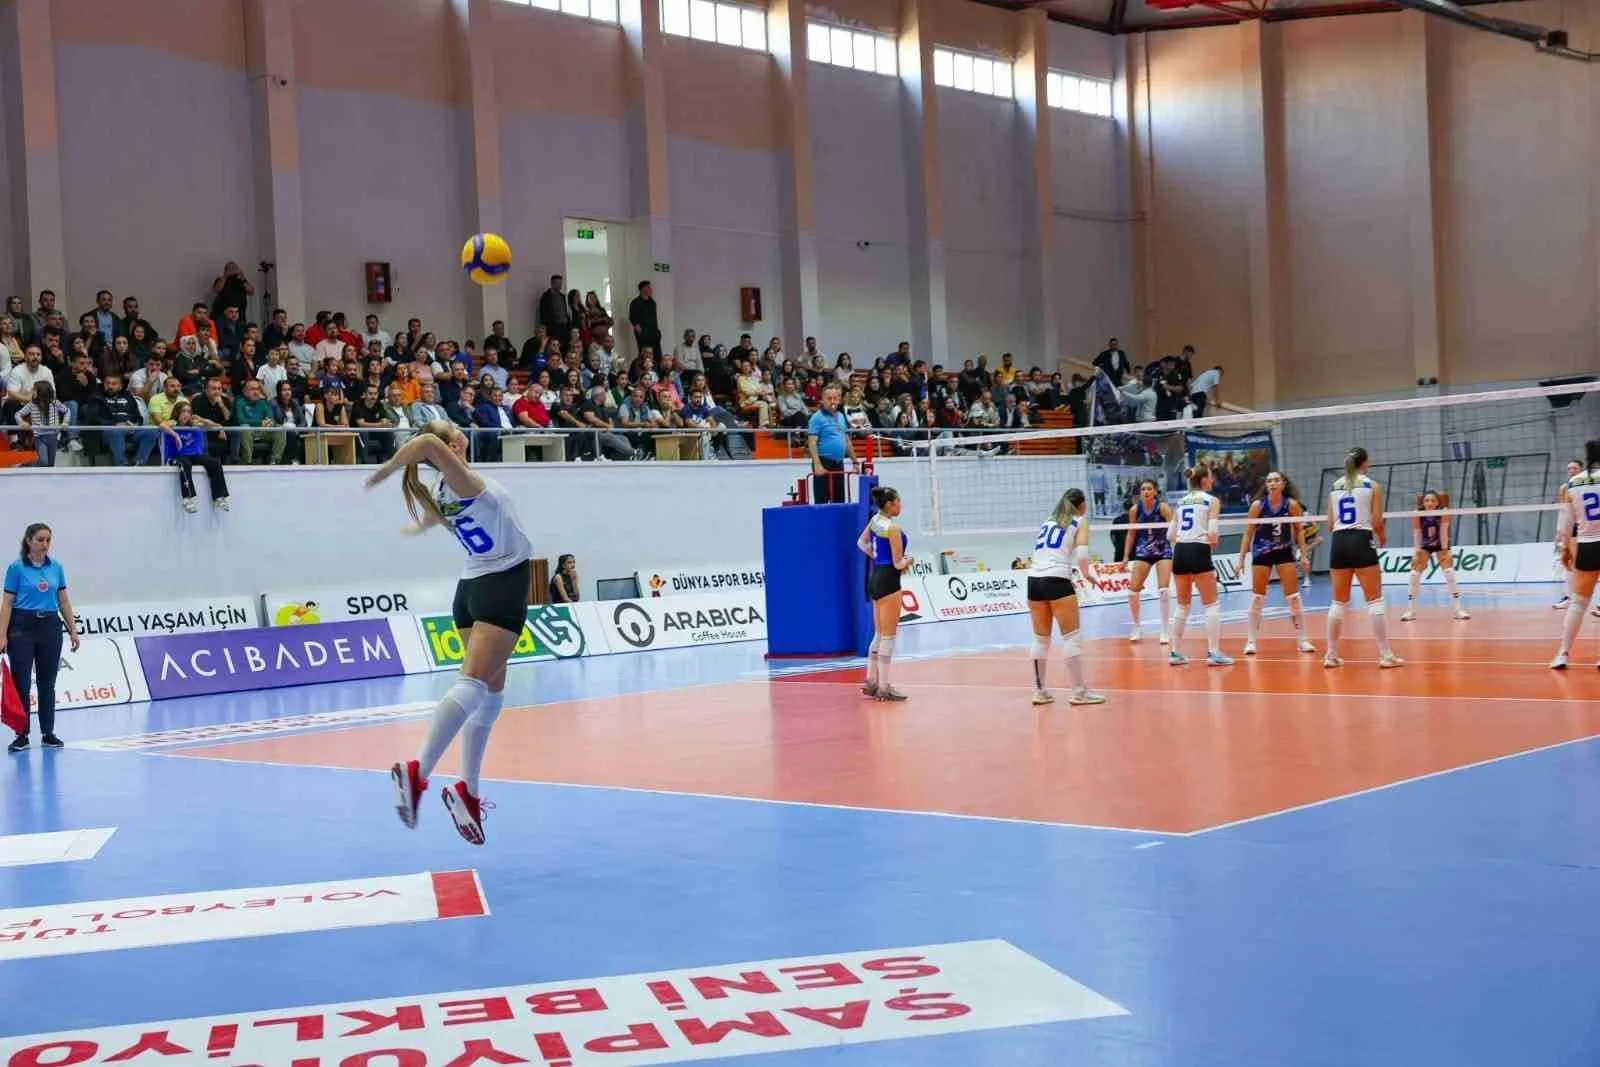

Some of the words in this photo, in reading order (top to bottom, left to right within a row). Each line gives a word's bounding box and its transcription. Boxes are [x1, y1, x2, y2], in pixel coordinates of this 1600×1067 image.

[1181, 508, 1195, 530] 5
[1337, 496, 1357, 525] 6
[1034, 524, 1066, 550] 20
[1271, 522, 1282, 536] 3
[672, 573, 710, 590] DÜNYA
[712, 573, 743, 588] SPOR
[743, 570, 765, 588] BAŞ
[970, 580, 1017, 593] ARABICA
[346, 593, 409, 615] SPOR
[138, 610, 206, 633] YAŞAM
[209, 604, 247, 629] İÇİN
[663, 605, 765, 632] ARABICA
[691, 630, 720, 642] Coffee
[722, 629, 747, 640] House
[161, 634, 391, 681] ACIBADEM
[64, 689, 81, 703] 1.
[83, 682, 117, 702] LİGİ
[73, 888, 401, 922] VOLEYBOL
[646, 954, 942, 1012] SENİ
[232, 987, 973, 1067] ŞAMPİYO
